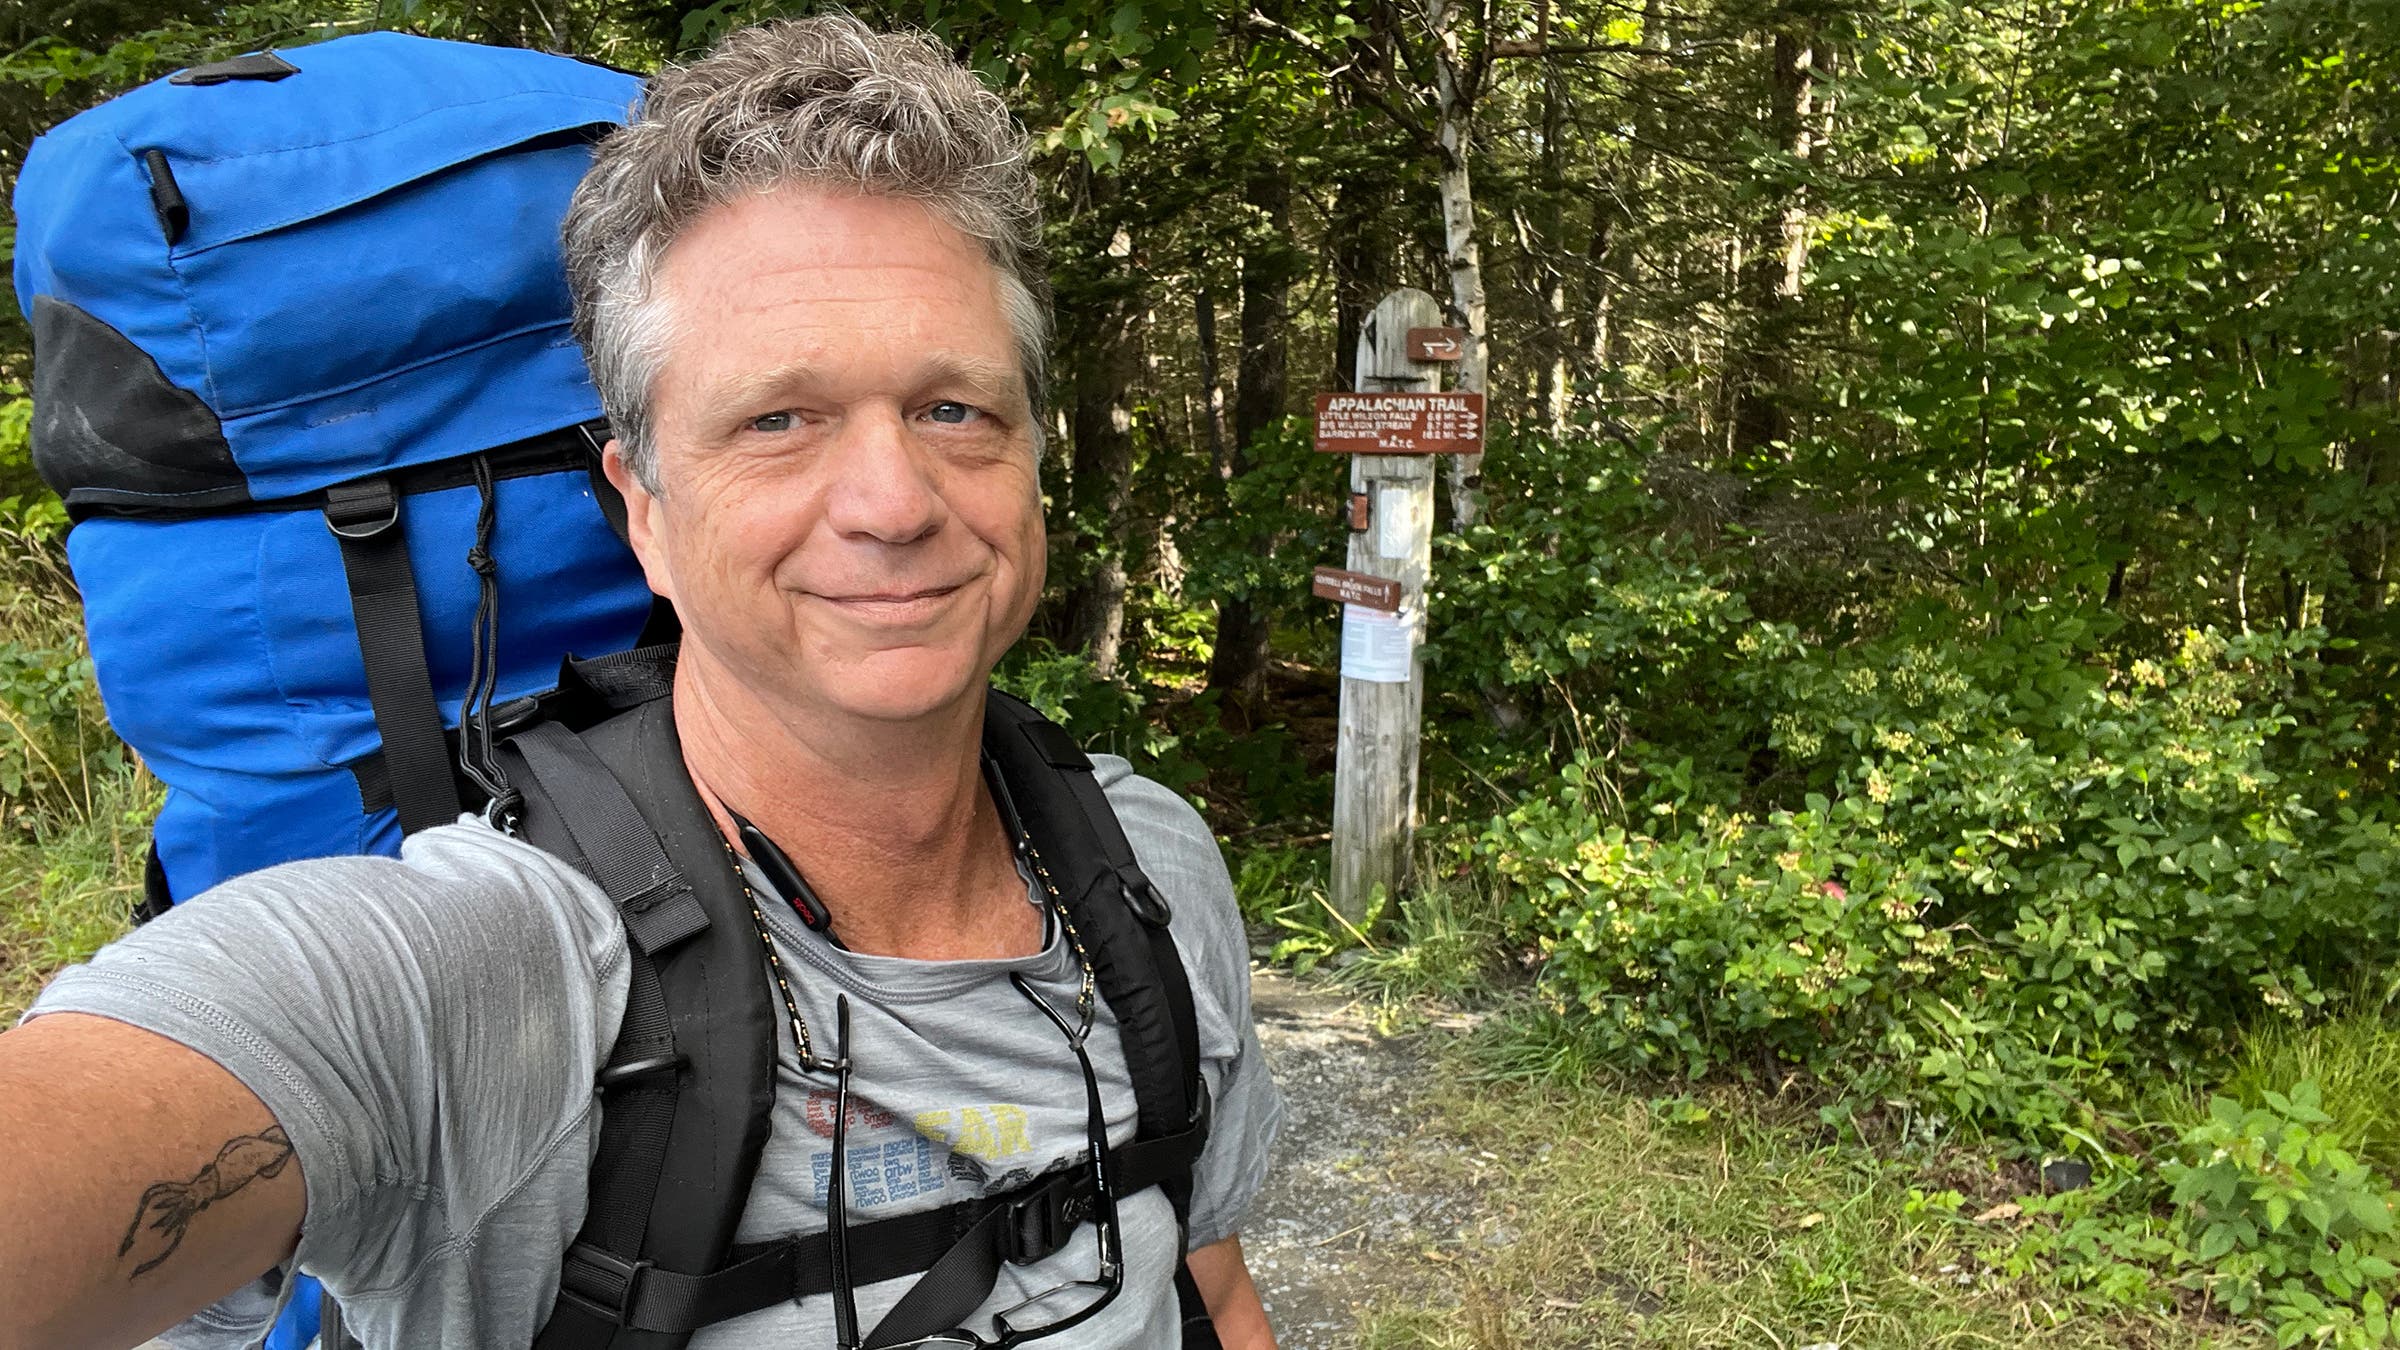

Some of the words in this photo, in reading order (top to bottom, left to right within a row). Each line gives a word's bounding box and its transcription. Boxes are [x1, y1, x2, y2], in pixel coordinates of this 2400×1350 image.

[1328, 398, 1425, 411] APPALACHIAN
[1428, 398, 1468, 411] TRAIL
[1320, 412, 1350, 421] LITTLE
[1351, 412, 1387, 421] WILSON
[1389, 412, 1417, 421] FALLS
[1320, 421, 1336, 430] BIG
[1338, 421, 1373, 430] WILSON
[1375, 421, 1412, 431] STREAM
[1319, 430, 1356, 439] BARREN
